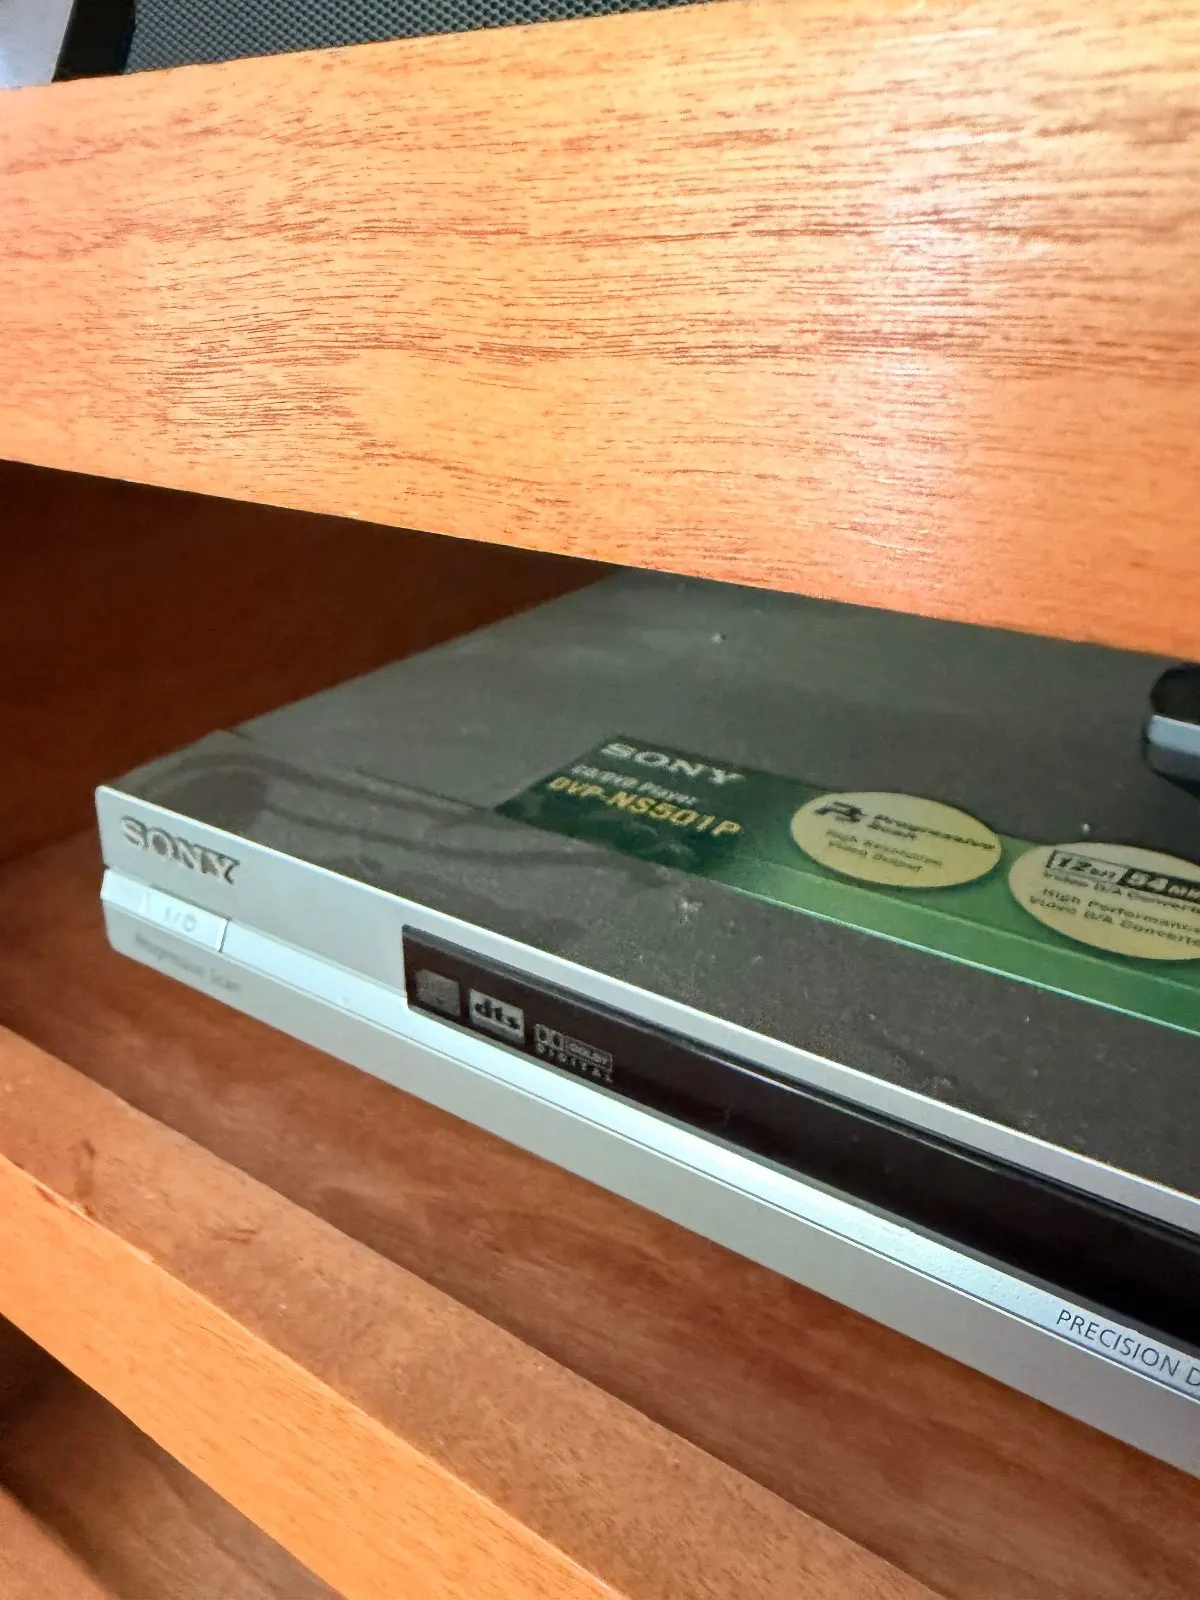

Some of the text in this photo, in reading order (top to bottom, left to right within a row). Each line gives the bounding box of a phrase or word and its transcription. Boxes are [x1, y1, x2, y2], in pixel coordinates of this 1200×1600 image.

[601, 742, 744, 785] SONY
[548, 776, 742, 837] DVP-NS501P
[120, 815, 240, 885] SONY
[474, 998, 521, 1031] dts
[1056, 1309, 1180, 1377] PRECISION
